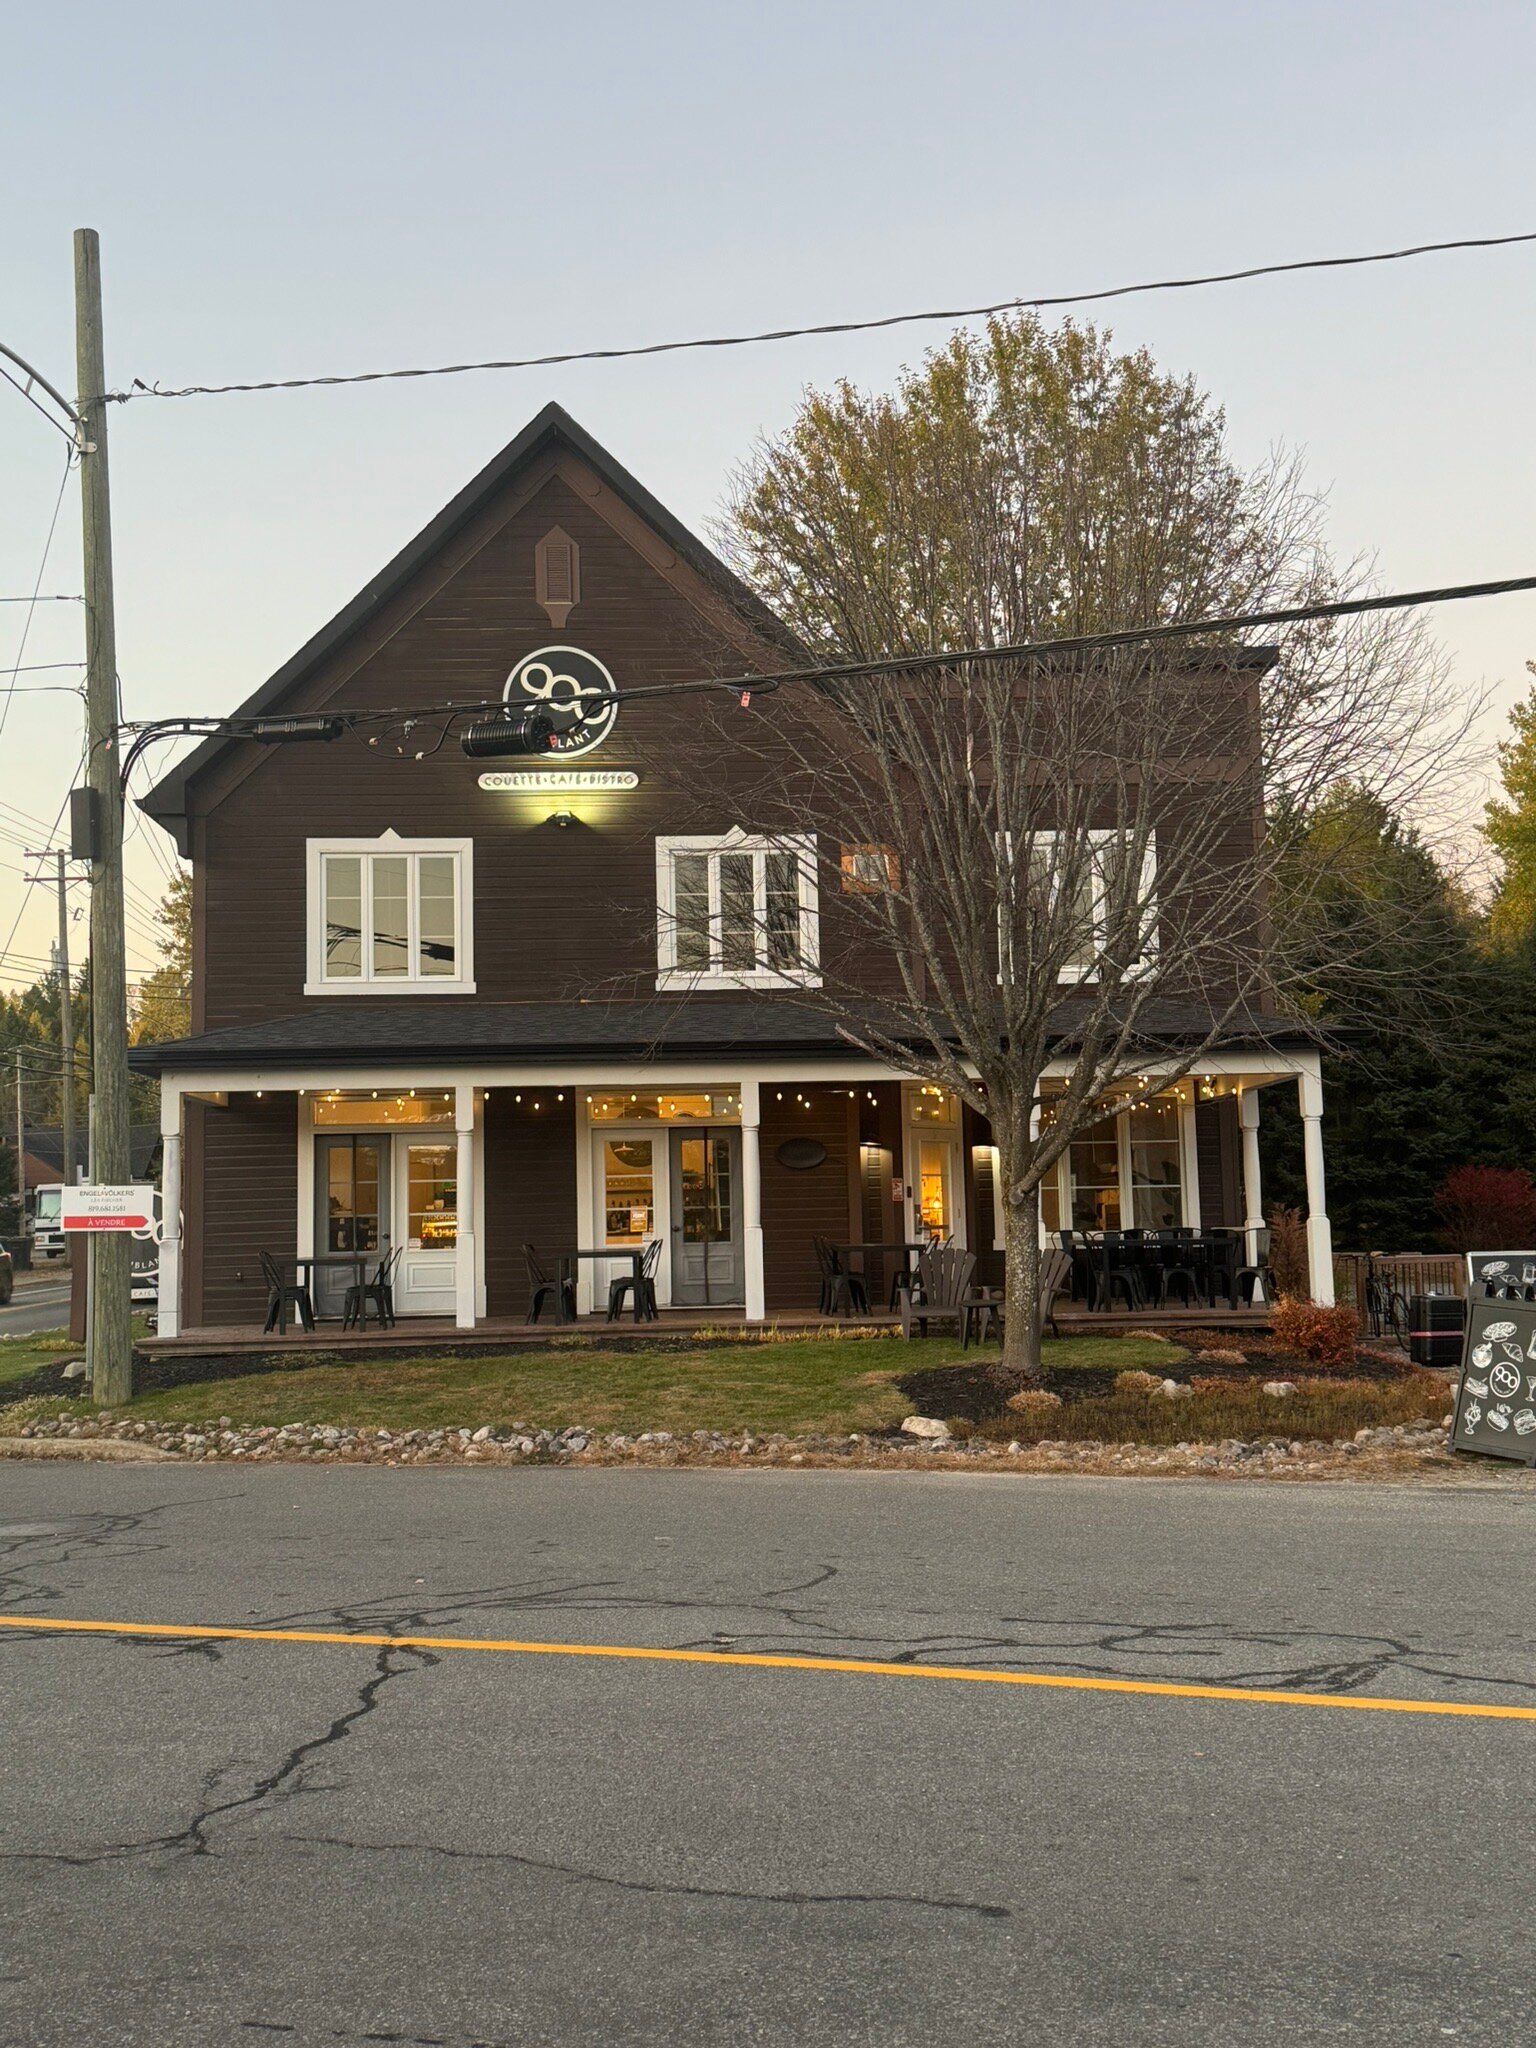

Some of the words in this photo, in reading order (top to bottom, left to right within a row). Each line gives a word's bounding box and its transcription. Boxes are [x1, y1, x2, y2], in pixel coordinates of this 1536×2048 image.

[484, 775, 541, 786] COUETTE
[589, 773, 634, 785] BISTRO
[95, 1218, 126, 1226] VENDRE
[1495, 1366, 1518, 1389] 900
